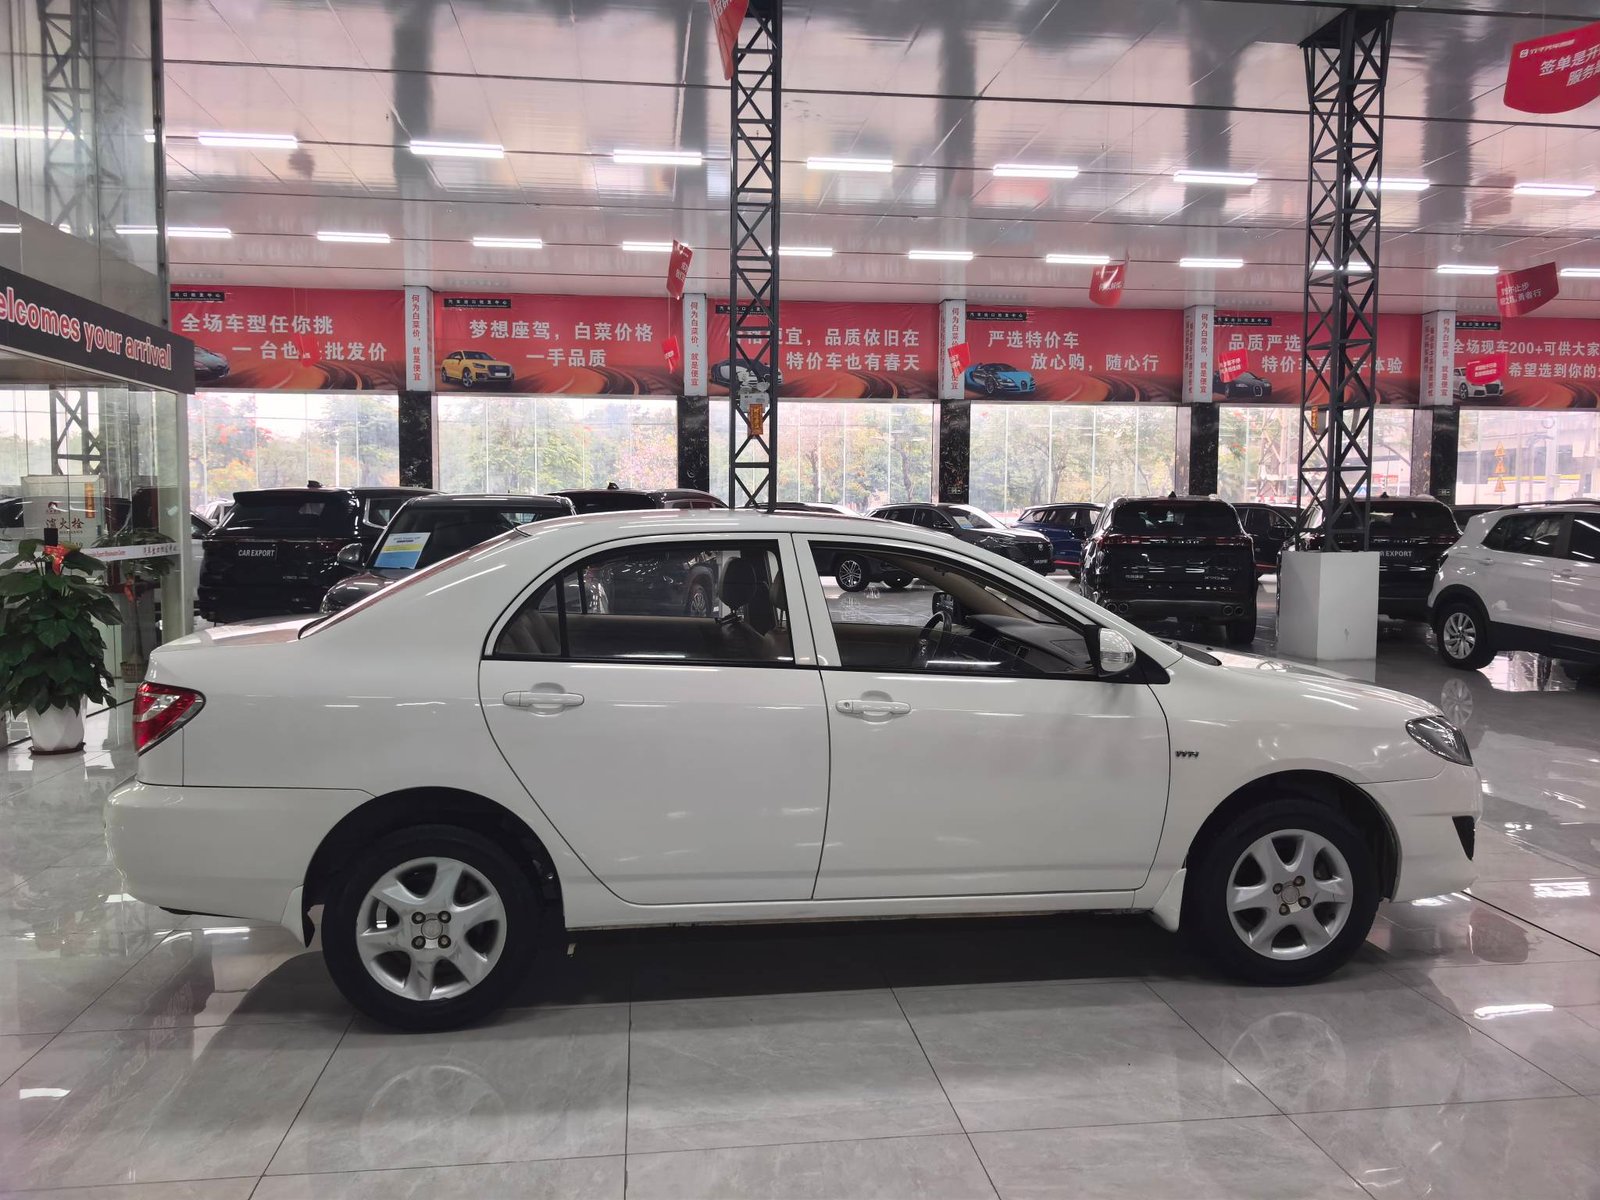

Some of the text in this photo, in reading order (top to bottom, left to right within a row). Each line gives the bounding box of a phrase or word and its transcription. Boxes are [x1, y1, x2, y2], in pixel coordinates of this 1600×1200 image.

[181, 313, 334, 335] 全场车型任你挑
[469, 319, 653, 342] 梦想座驾，白菜价格
[84, 321, 123, 352] your
[125, 336, 172, 370] arrival
[988, 330, 1079, 349] 严选特价车
[1229, 334, 1302, 352] 品质严选
[232, 340, 387, 361] 一台也批发价
[526, 348, 607, 368] 一手品质
[786, 352, 920, 371] 特价车也有春天
[1031, 353, 1159, 372] 放心购，随心行
[1508, 362, 1600, 378] 希望选到你的
[46, 517, 85, 530] 消火栓
[238, 549, 275, 557] CAR EXPORT
